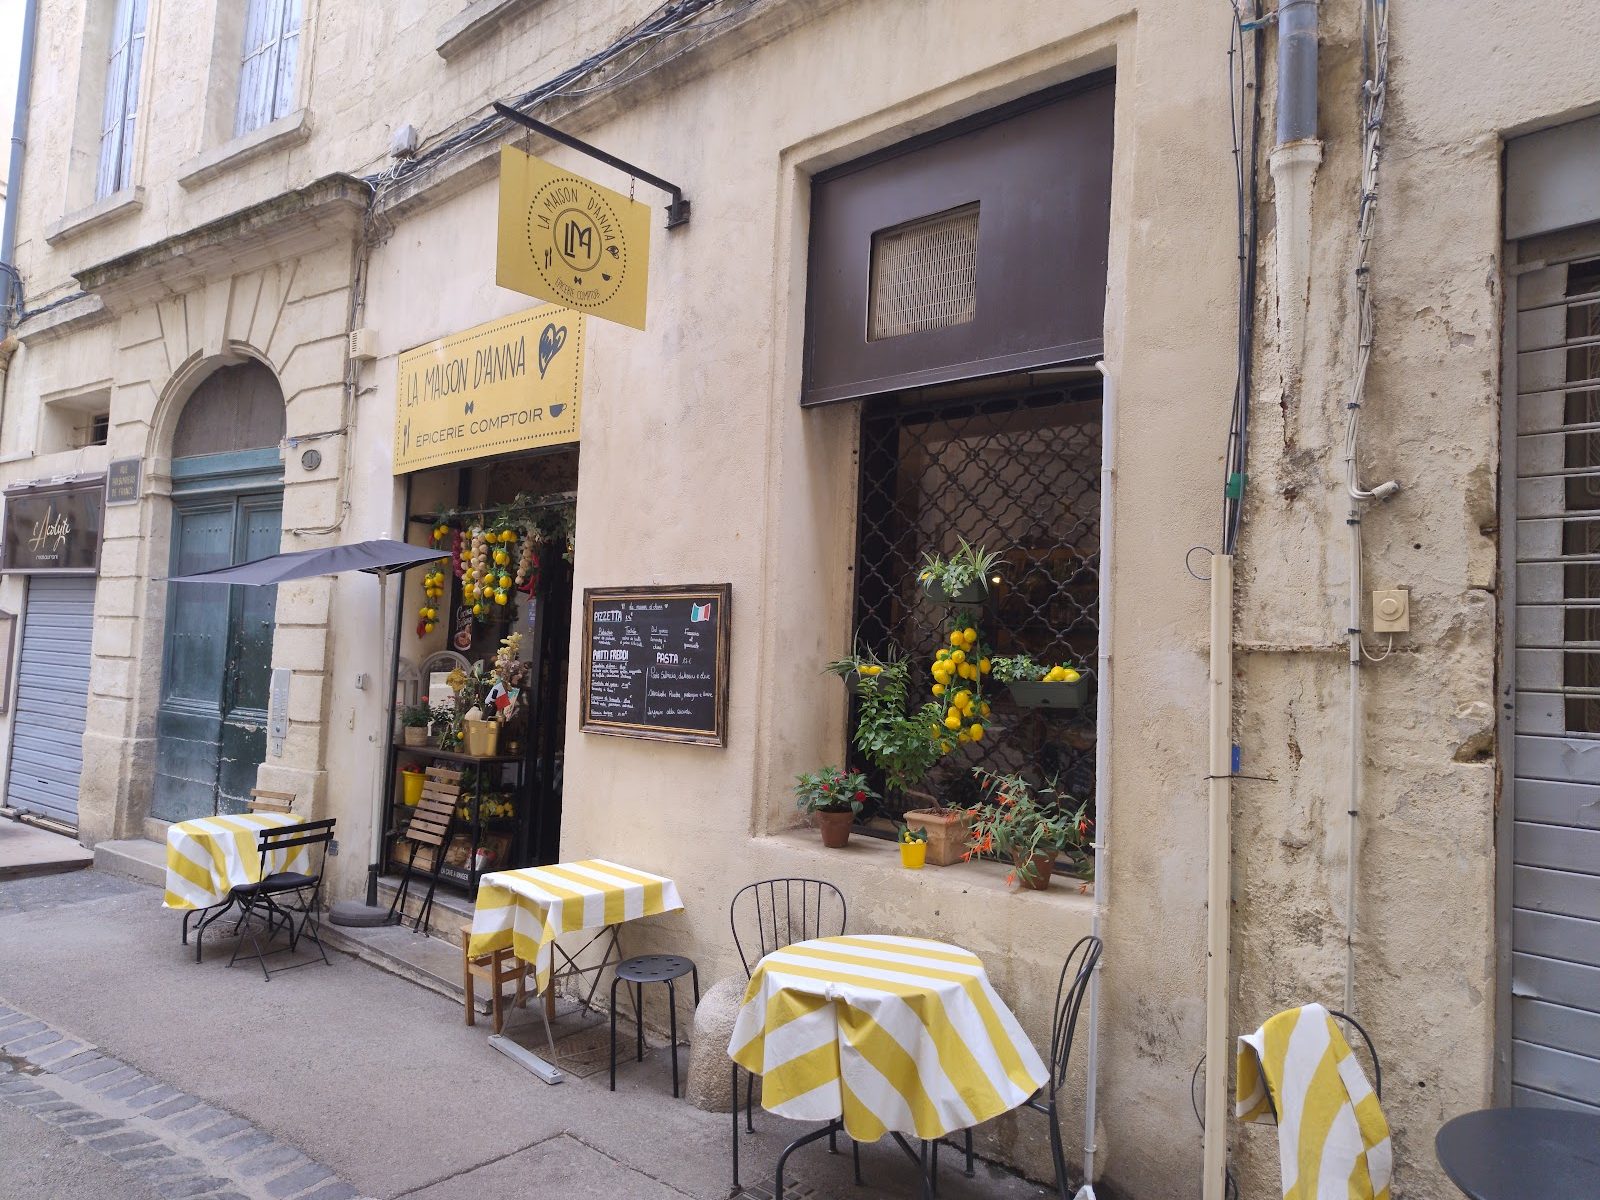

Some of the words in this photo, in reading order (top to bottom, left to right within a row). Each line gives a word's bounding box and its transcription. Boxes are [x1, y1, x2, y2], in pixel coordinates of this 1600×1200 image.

[543, 186, 579, 213] MAISON
[537, 214, 550, 230] LA
[587, 198, 616, 241] D'ANNA
[407, 372, 419, 408] LA
[424, 358, 469, 402] MAISON
[473, 335, 526, 390] D'ANNA
[470, 407, 543, 435] COMPTOIR
[594, 610, 622, 622] PIZZETTA
[656, 652, 679, 664] PASTA
